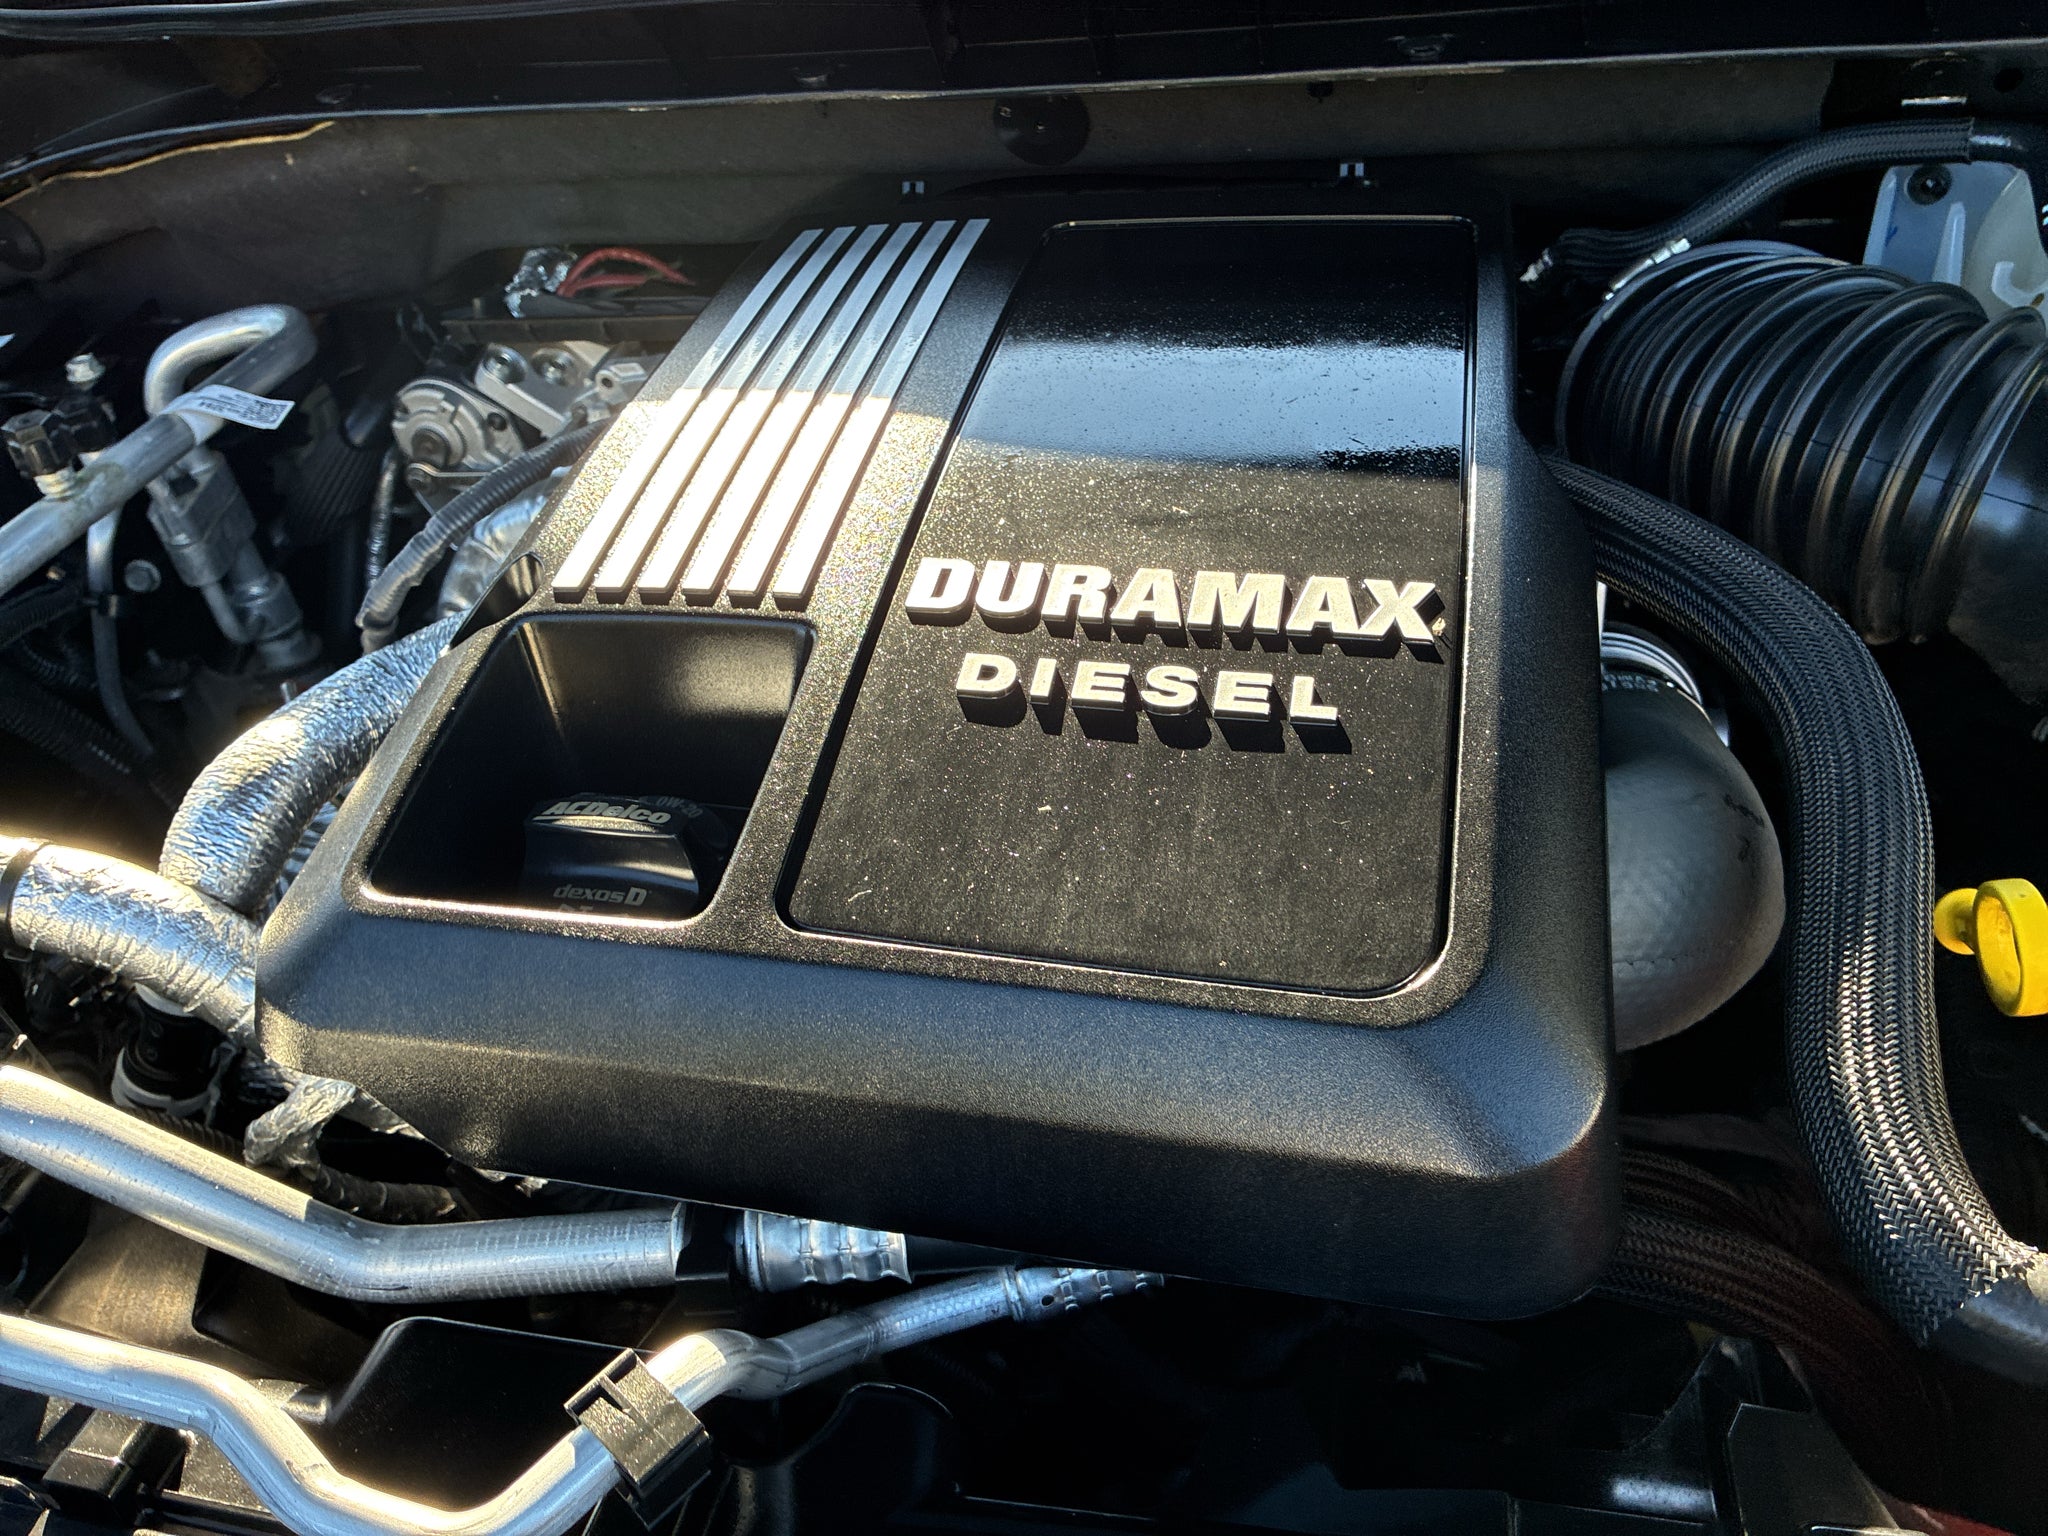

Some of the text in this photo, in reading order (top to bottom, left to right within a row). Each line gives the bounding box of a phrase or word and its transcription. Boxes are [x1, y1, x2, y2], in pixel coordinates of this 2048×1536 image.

[904, 557, 1436, 643] DURAMAX
[956, 652, 1338, 724] DIESEL
[540, 801, 672, 824] ACDelco
